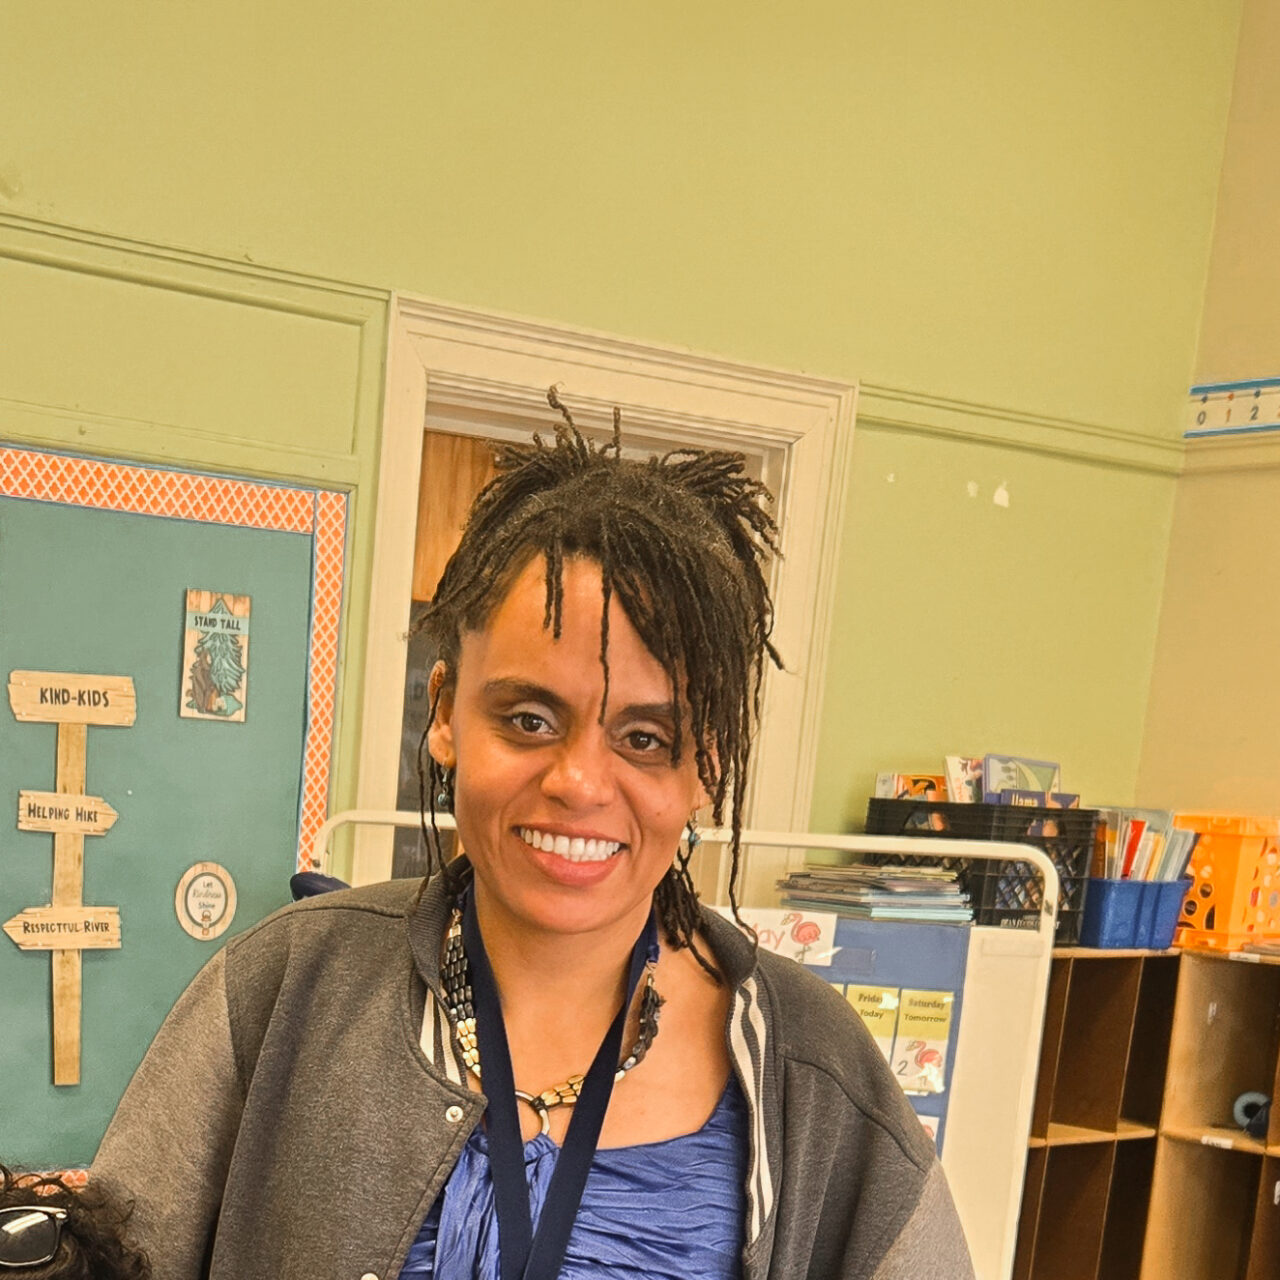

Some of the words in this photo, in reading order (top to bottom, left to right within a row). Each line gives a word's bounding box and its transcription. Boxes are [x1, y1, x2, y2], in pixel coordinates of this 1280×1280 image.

[1196, 410, 1207, 426] 0
[1225, 408, 1231, 424] 1
[1249, 404, 1260, 422] 2
[194, 615, 218, 628] STAND
[220, 618, 241, 631] TALL
[39, 687, 110, 708] KIND-KIDS
[907, 998, 946, 1010] Saturday
[859, 1008, 884, 1020] Today
[904, 1013, 947, 1023] Tomorrow
